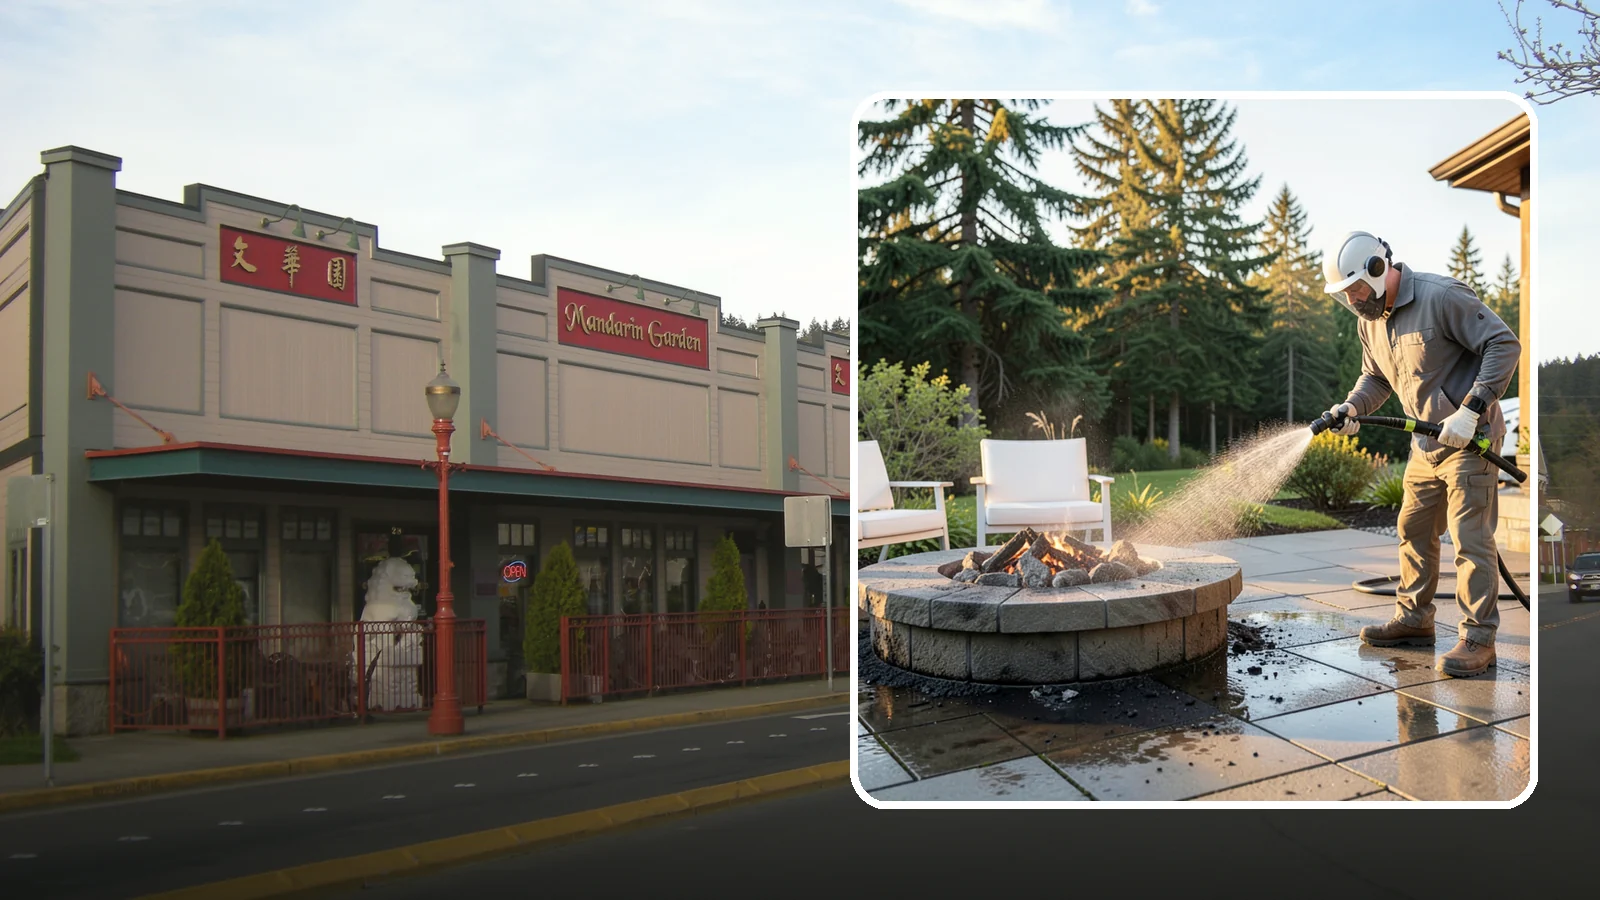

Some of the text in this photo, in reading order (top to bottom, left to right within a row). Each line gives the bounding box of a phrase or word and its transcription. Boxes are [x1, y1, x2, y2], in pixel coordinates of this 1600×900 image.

[231, 235, 346, 291] 文華園
[564, 302, 702, 352] Mandarin Garden
[503, 565, 527, 578] OPEN
